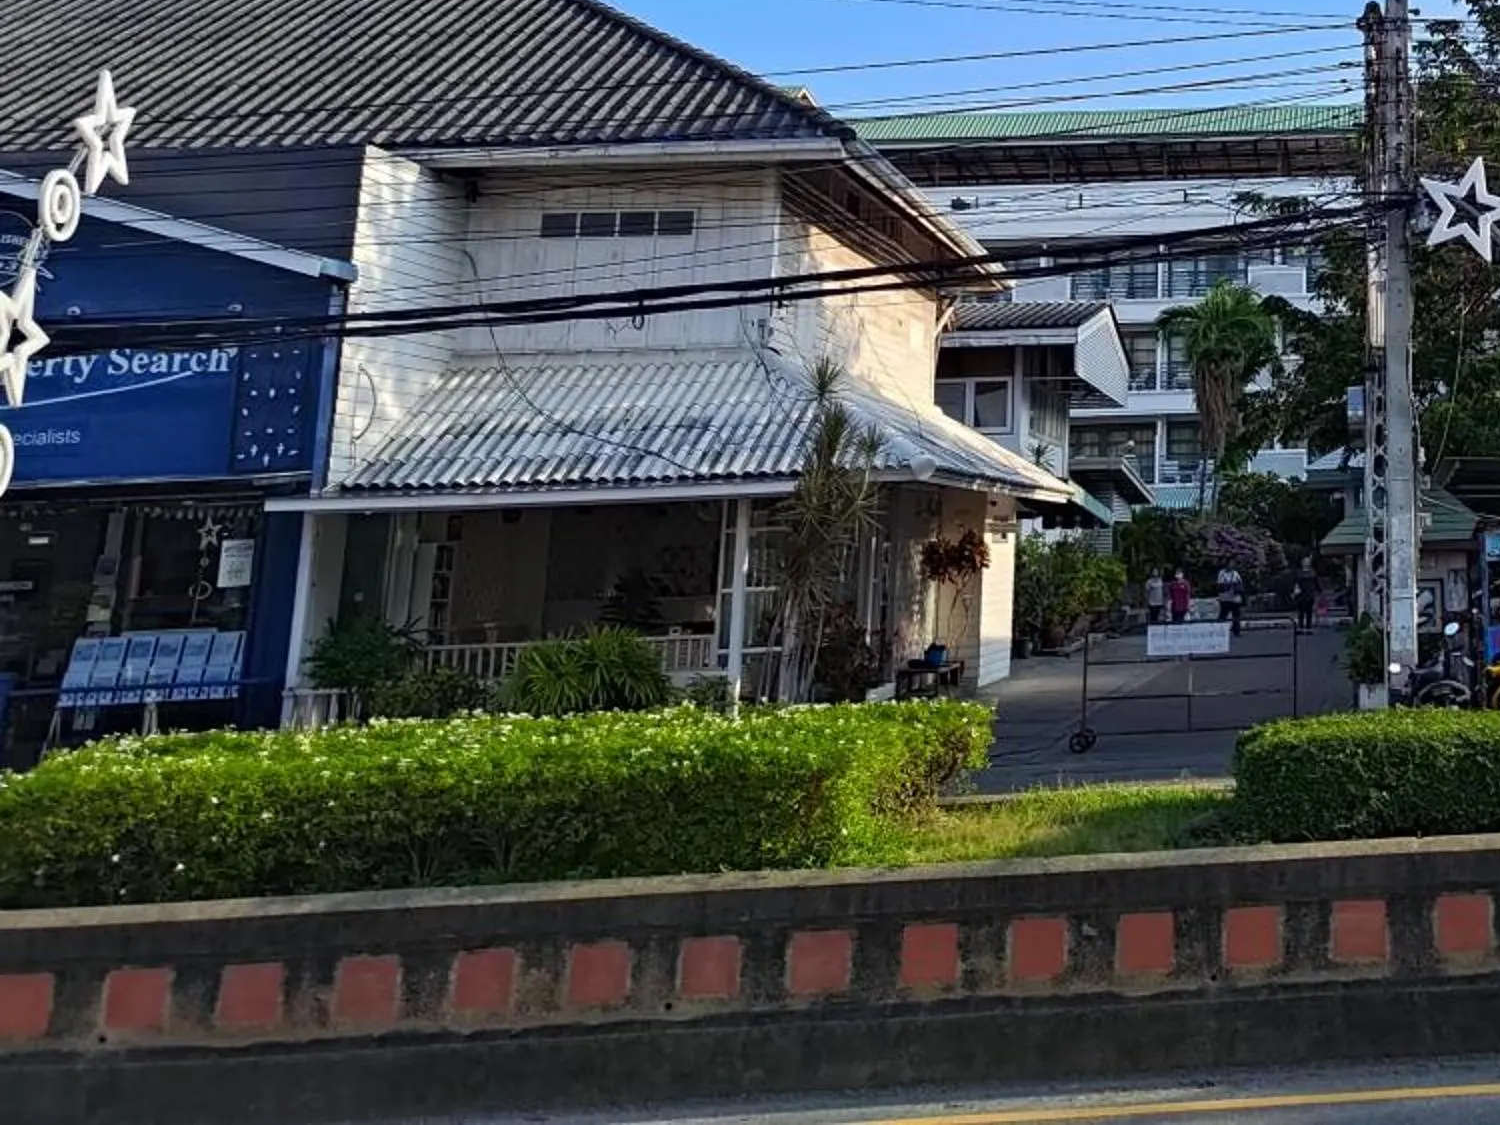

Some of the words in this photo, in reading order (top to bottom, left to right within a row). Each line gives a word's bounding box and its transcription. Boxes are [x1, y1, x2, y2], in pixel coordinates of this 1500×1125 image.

[26, 354, 100, 384] erty
[107, 347, 230, 375] Search
[13, 428, 81, 446] ecialists
